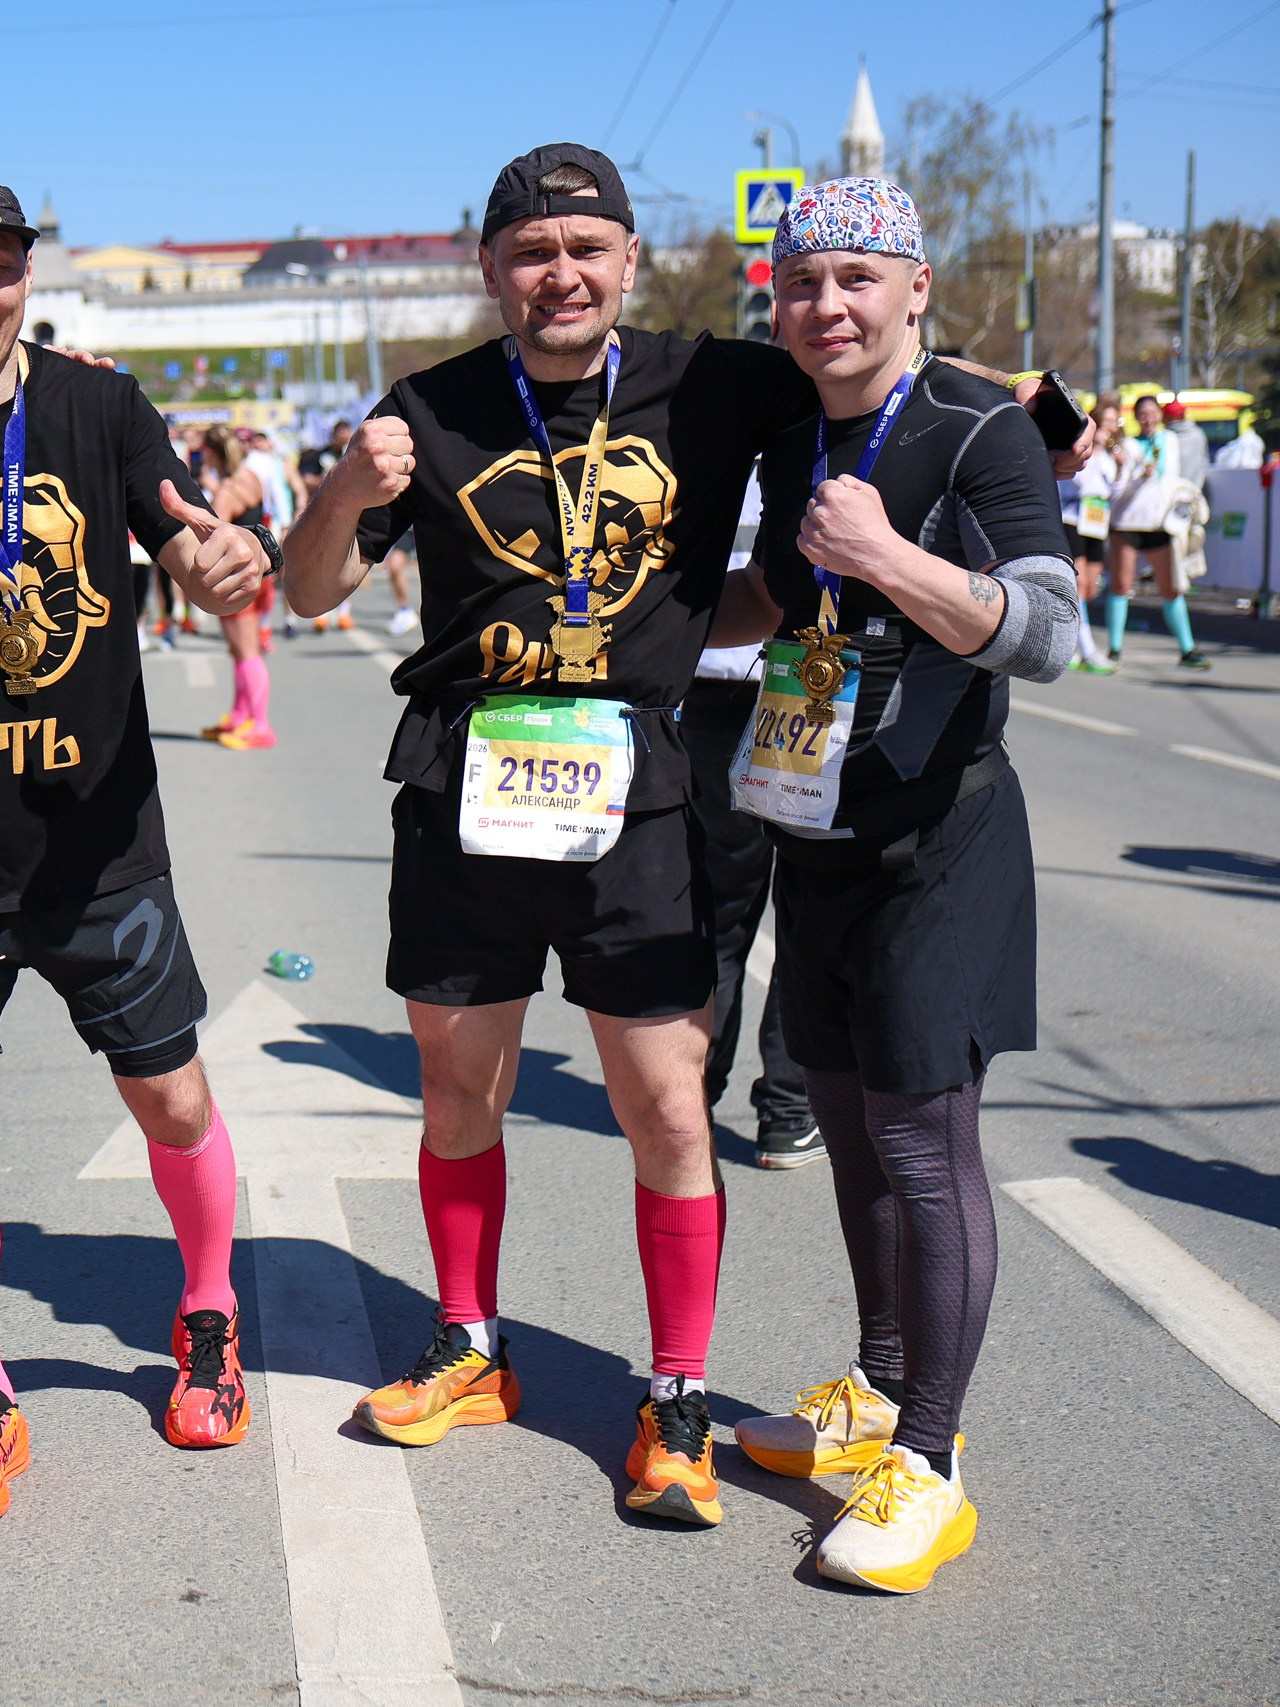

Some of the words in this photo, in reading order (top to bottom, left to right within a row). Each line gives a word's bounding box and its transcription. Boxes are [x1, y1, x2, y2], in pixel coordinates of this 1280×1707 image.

[875, 415, 888, 438] СБЕР
[581, 490, 594, 524] 42.2
[497, 713, 523, 723] СБЕР
[754, 708, 824, 757] 22492
[467, 743, 488, 753] 2026
[497, 756, 602, 796] 21539
[745, 777, 769, 789] МАГНИТ
[511, 794, 581, 810] АЛЕКСАНДР
[491, 819, 535, 830] МАГНИТ
